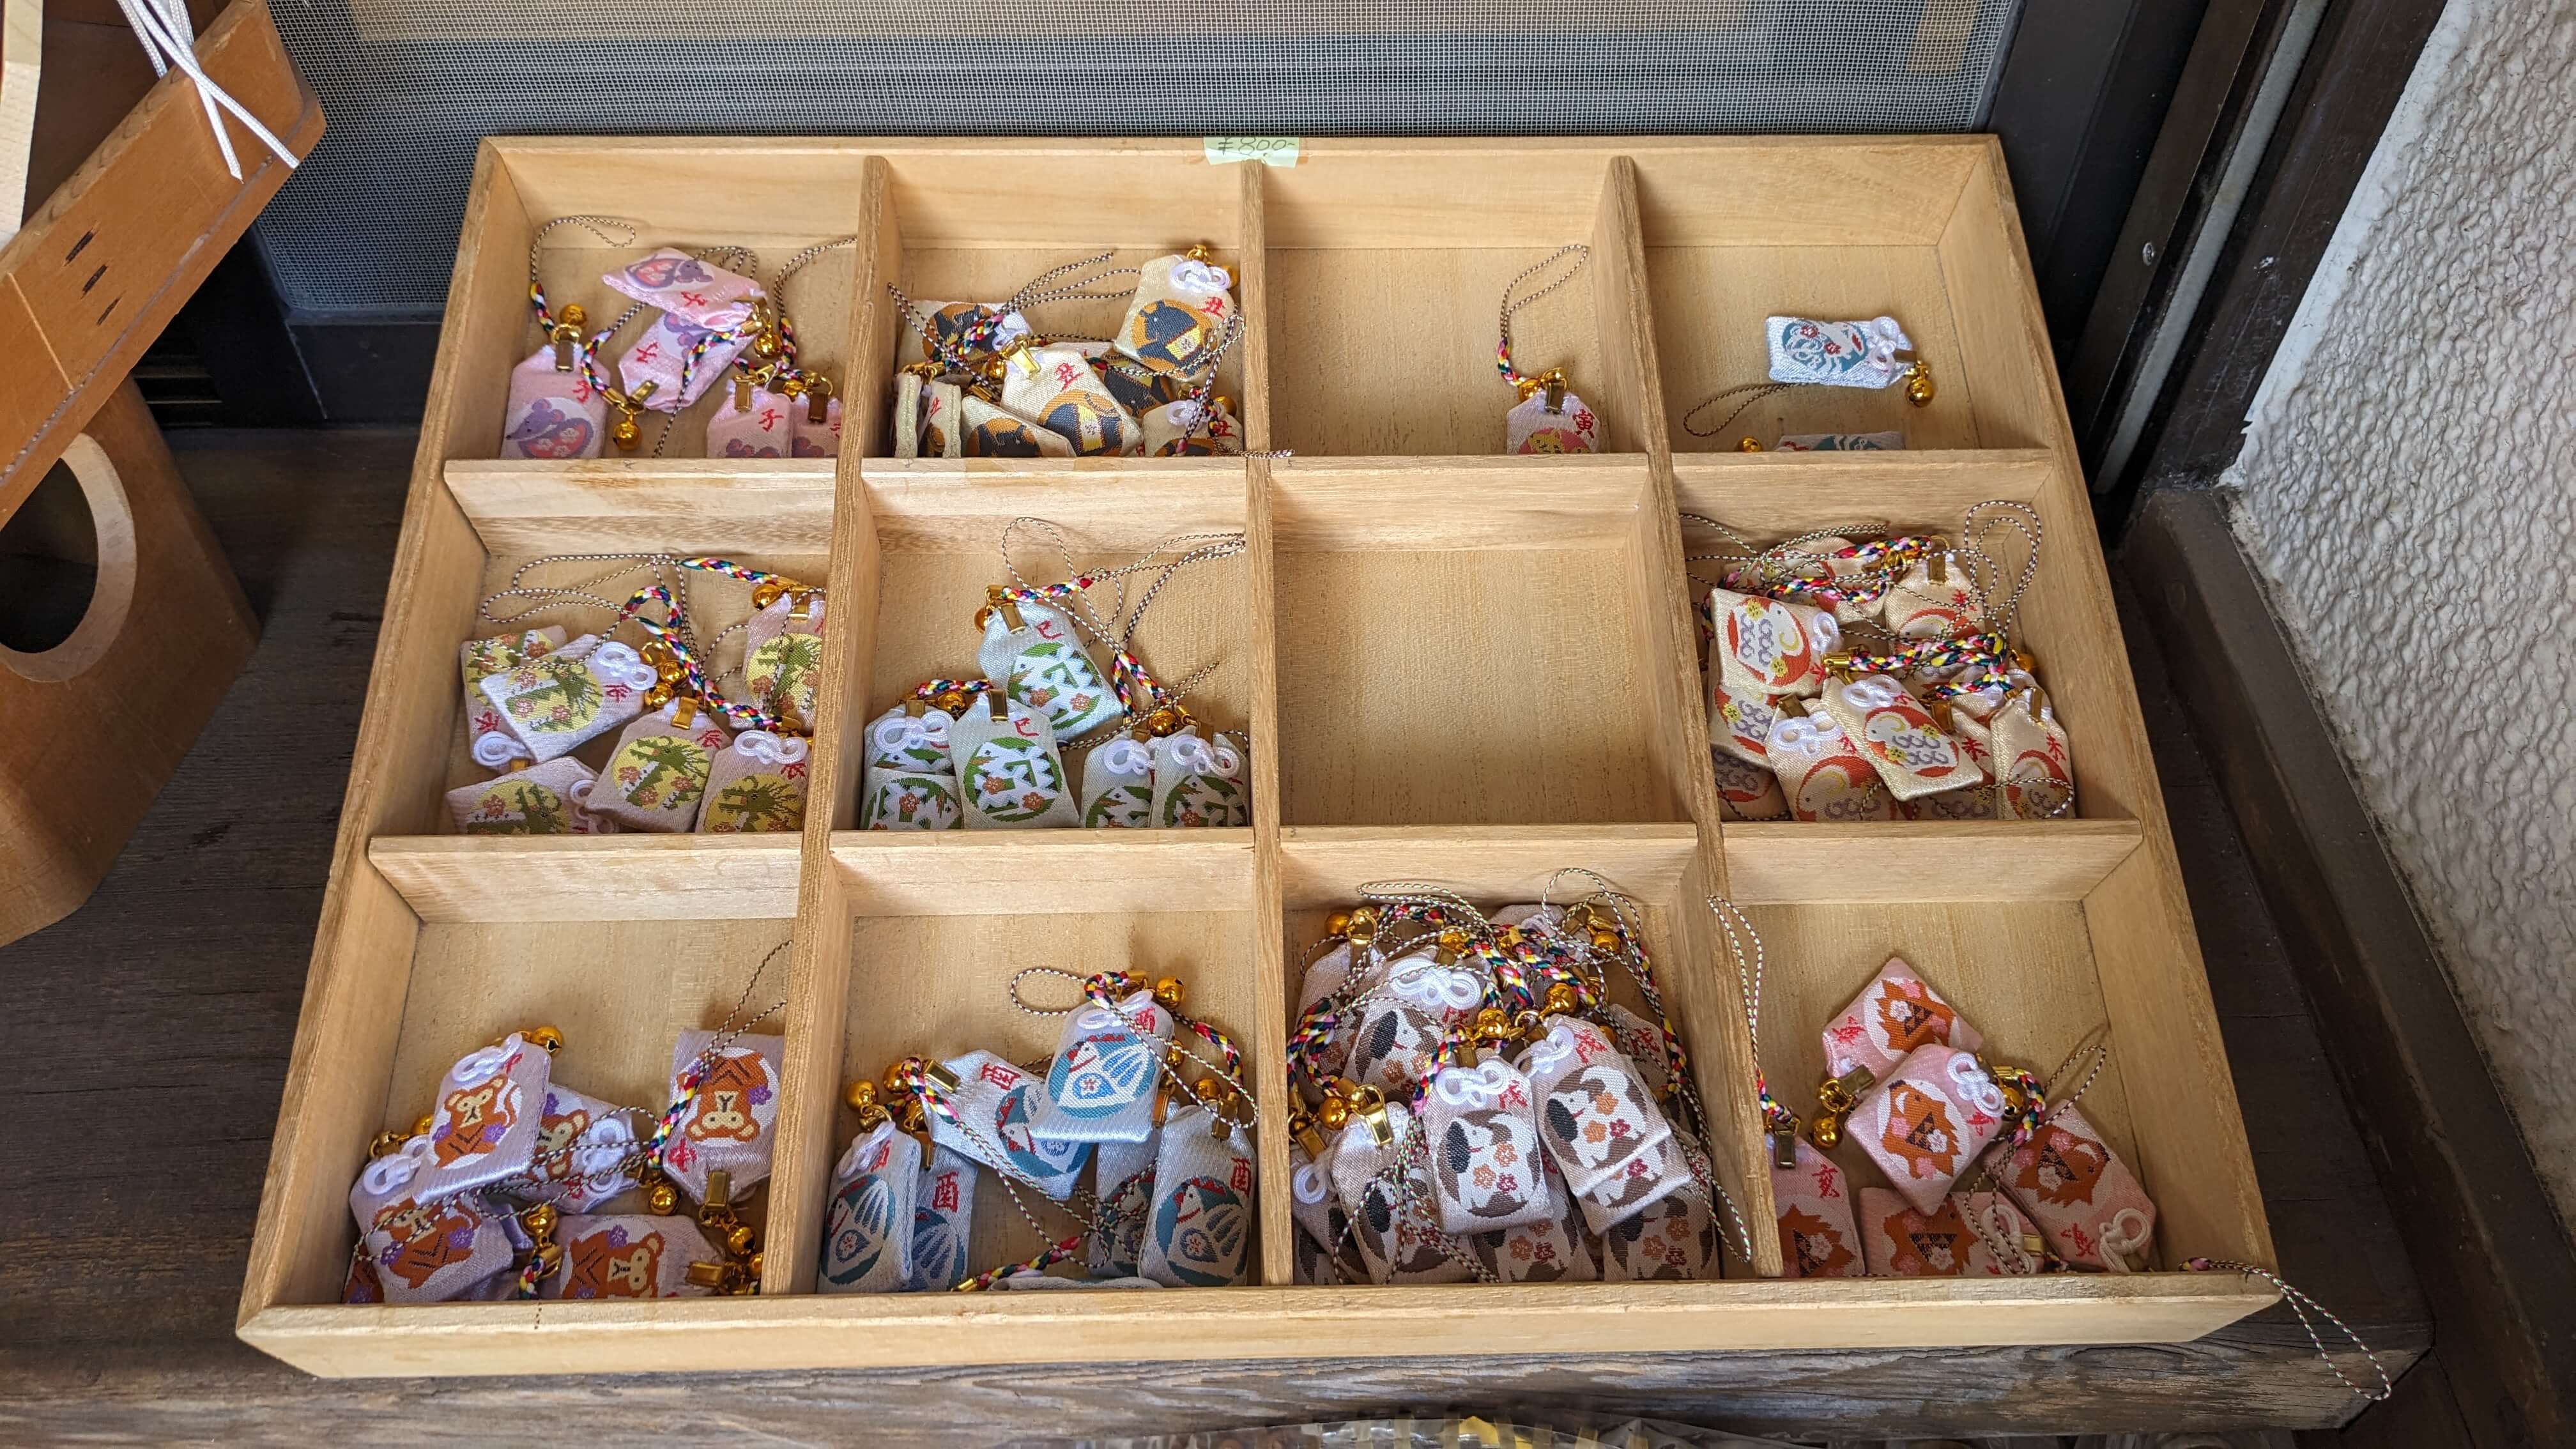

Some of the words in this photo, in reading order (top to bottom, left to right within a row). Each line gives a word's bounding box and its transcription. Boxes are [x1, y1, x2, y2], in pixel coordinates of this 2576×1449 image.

[680, 291, 707, 308] 子
[636, 342, 659, 364] 子
[758, 409, 784, 431] 子
[1572, 408, 1595, 439] 寅
[696, 730, 723, 749] 辰
[981, 1063, 1022, 1091] 酉
[668, 1138, 696, 1172] 申
[932, 1172, 958, 1213] 酉
[1229, 1158, 1252, 1198] 酉
[1812, 1163, 1840, 1199] 亥
